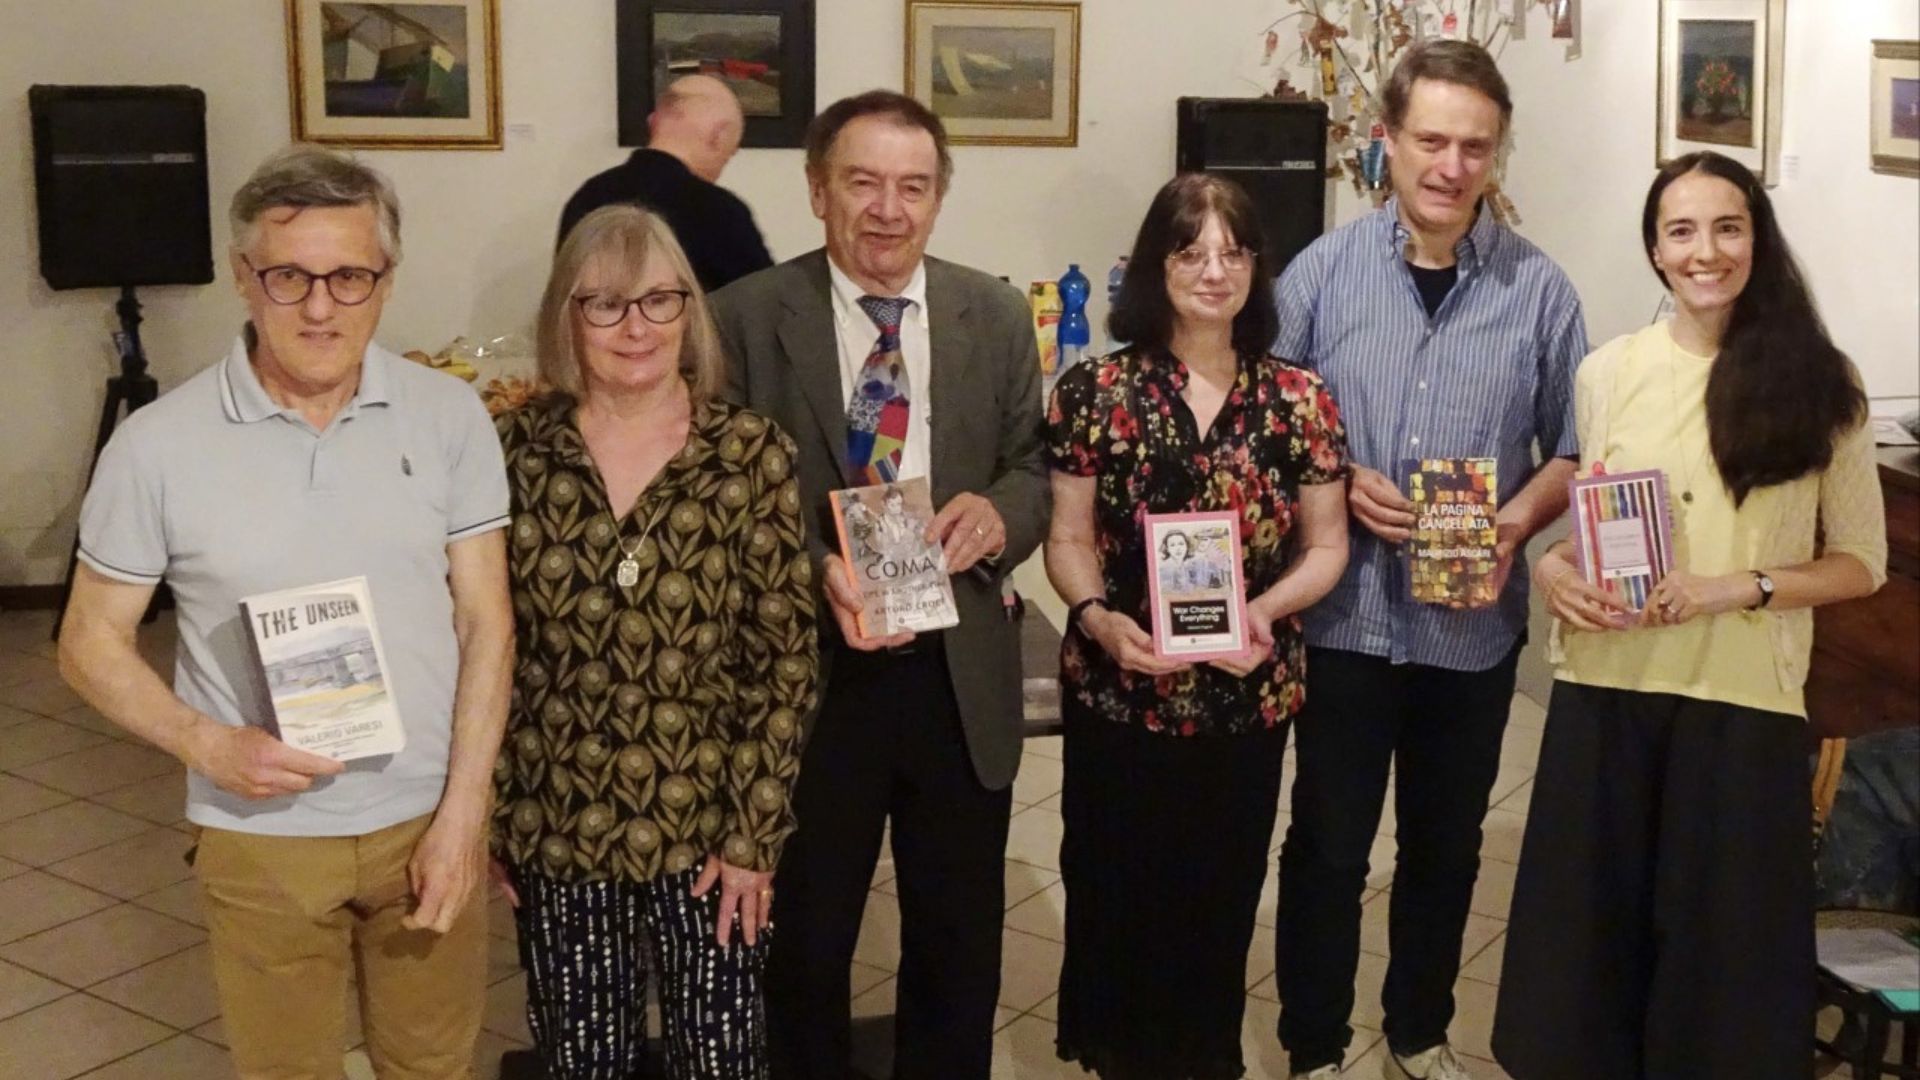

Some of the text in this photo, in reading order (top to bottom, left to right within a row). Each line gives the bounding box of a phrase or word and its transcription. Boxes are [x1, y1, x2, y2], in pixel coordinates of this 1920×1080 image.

[1423, 503, 1484, 516] LA PAGINA
[1418, 516, 1490, 529] CANCELLATA
[865, 556, 937, 581] COMA
[1172, 605, 1225, 615] War Changes
[256, 599, 360, 639] THE UNSEEN
[1179, 614, 1220, 623] Everything
[296, 727, 343, 745] VALERIO
